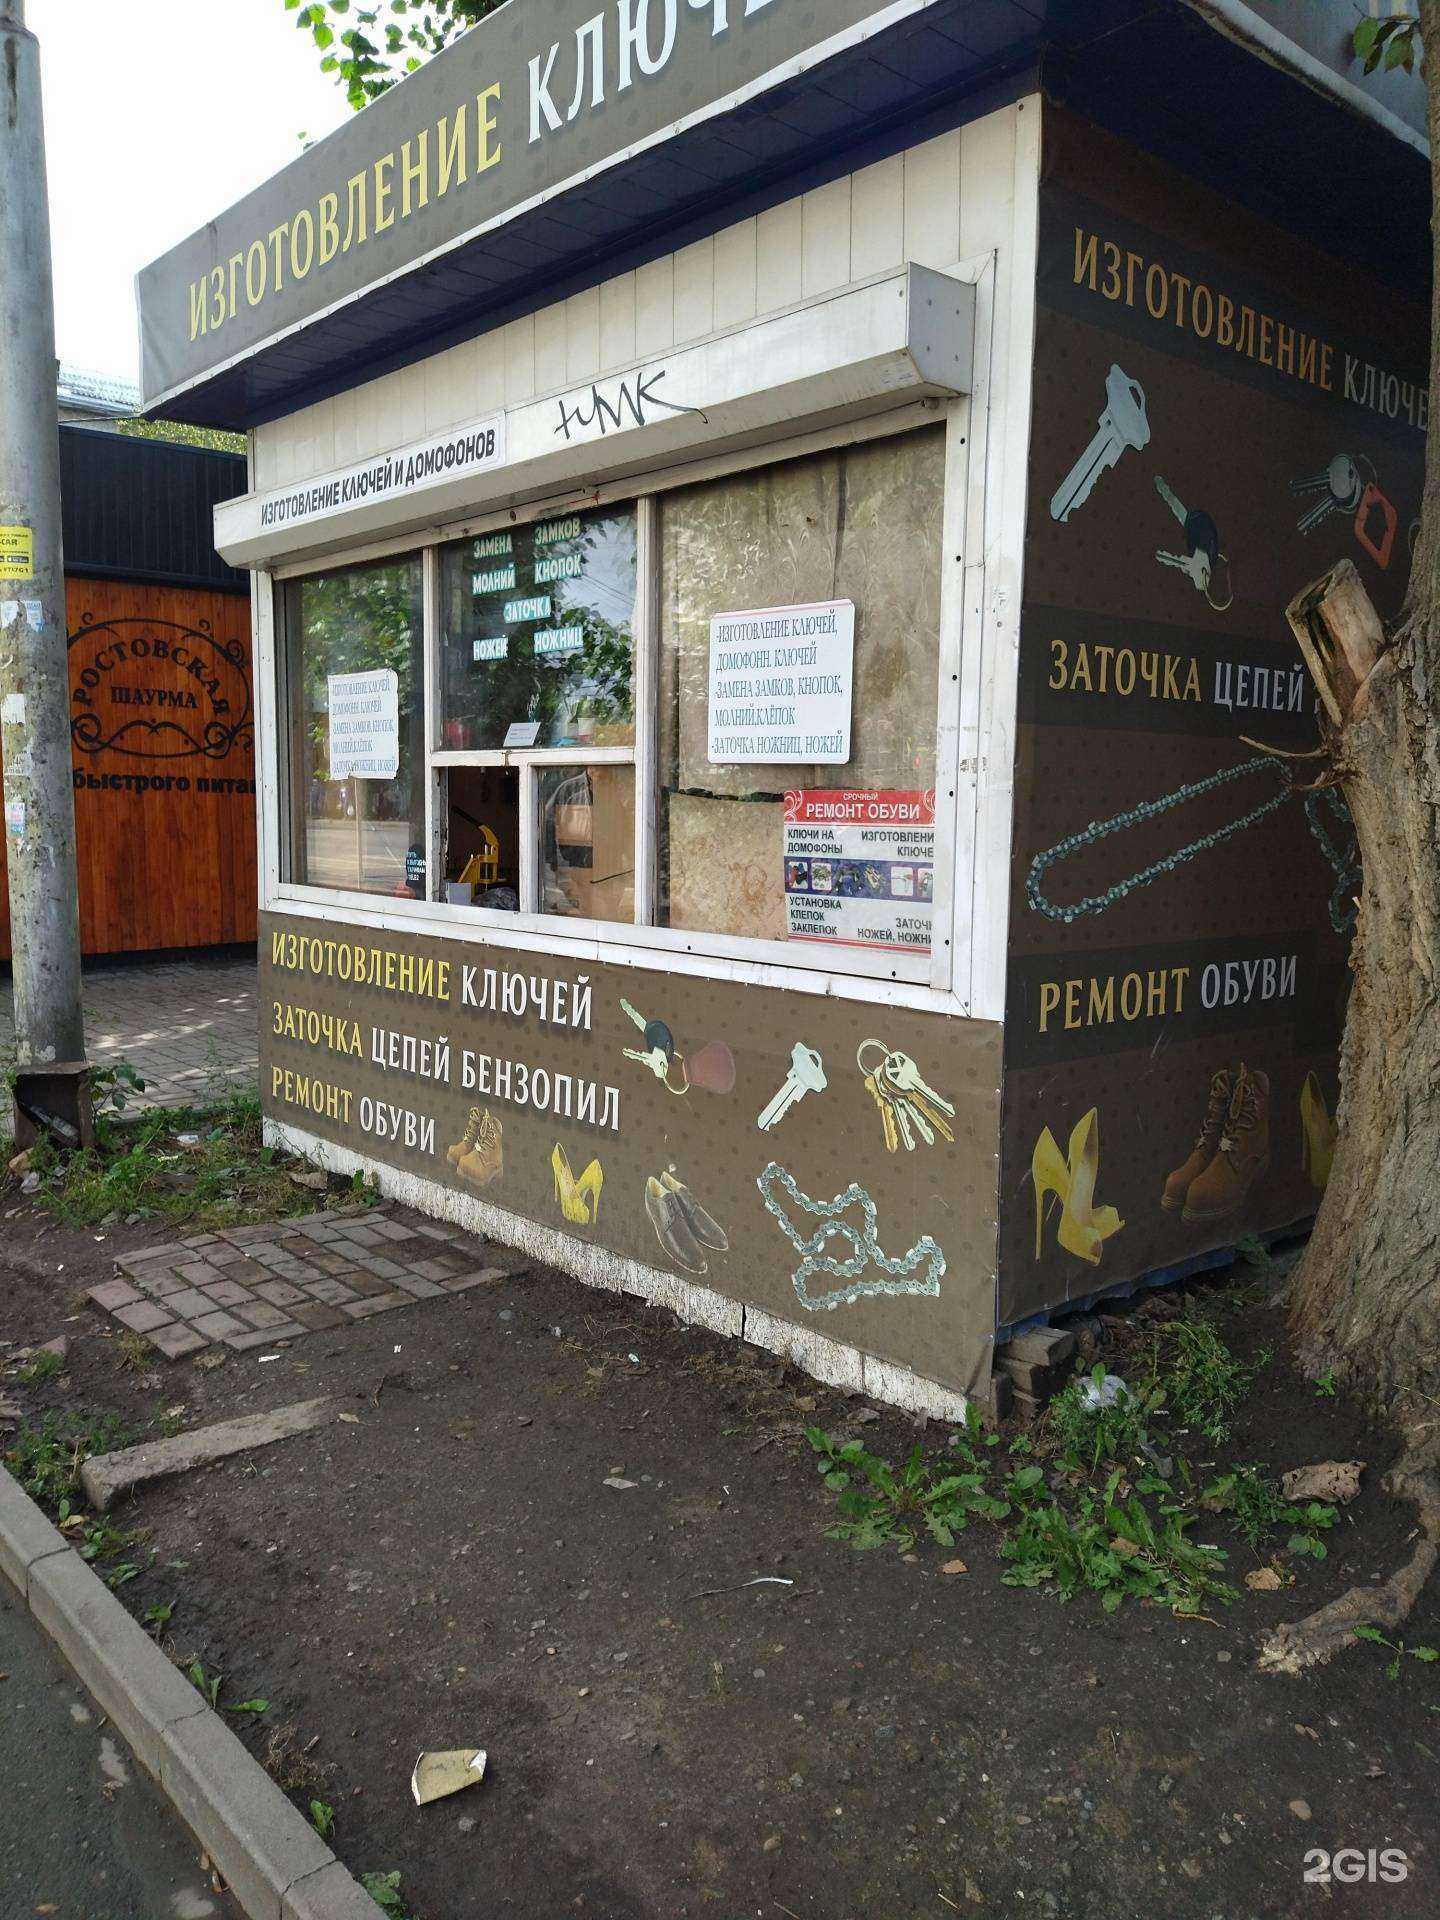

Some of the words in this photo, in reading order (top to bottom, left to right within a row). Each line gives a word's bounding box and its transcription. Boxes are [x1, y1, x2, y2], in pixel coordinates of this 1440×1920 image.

[188, 82, 501, 341] ИЗГОТОВЛЕНИЕ
[528, 0, 775, 144] КЛЮ
[1073, 226, 1336, 391] ИЗГОТОВЛЕНИЕ
[261, 482, 340, 526] ИЗГОТОВЛЕНИЕ
[342, 457, 392, 502] КЛЮЧЕЙ
[394, 460, 403, 485] И
[405, 429, 495, 486] ДОМОФОНОВ
[474, 534, 512, 558] ЗАМЕНА
[535, 517, 581, 545] ЗАМКОВ
[473, 562, 515, 595] МОЛНИЙ
[535, 554, 582, 584] КНОПОК
[505, 596, 551, 621] ЗАТОЧКА
[534, 627, 583, 653] НОЖНИЦ
[774, 641, 817, 667] КЛЮЧЕЙ
[73, 639, 230, 715] РОСТОВСКАЯ
[1048, 639, 1201, 702] ЗАТОЧКА
[1214, 661, 1304, 712] ЦЕПЕЙ
[111, 685, 198, 709] ШАУРМА
[805, 730, 843, 754] НОЖЕЙ
[73, 767, 190, 794] быстрого
[843, 792, 878, 801] СРОЧНЫЙ
[806, 803, 864, 818] РЕМОНТ
[868, 804, 920, 819] ОБУВИ
[787, 829, 819, 839] КЛЮЧИ
[822, 830, 834, 839] НА
[861, 831, 935, 843] ИЗГОТОВЛЕНИ
[787, 842, 843, 854] ДОМОФОНЫ
[897, 846, 934, 858] КЛЮЧЕ
[789, 896, 842, 910] УСТАНОВКА
[790, 909, 825, 921] КЛЕПОК
[791, 922, 838, 936] ЗАКЛЕПОК
[272, 932, 450, 1001] ИЗГОТОВЛЕНИЕ
[461, 964, 592, 1031] КЛЮЧЕЙ
[1038, 967, 1190, 1033] РЕМОНТ
[1201, 955, 1298, 1009] ОБУВИ
[273, 1001, 363, 1057] ЗАТОЧКА
[371, 1027, 450, 1083] ЦЕПЕЙ
[461, 1050, 621, 1131] БЕНЗОПИЛ
[271, 1065, 353, 1124] РЕМОНТ
[359, 1096, 435, 1156] ОБУВИ
